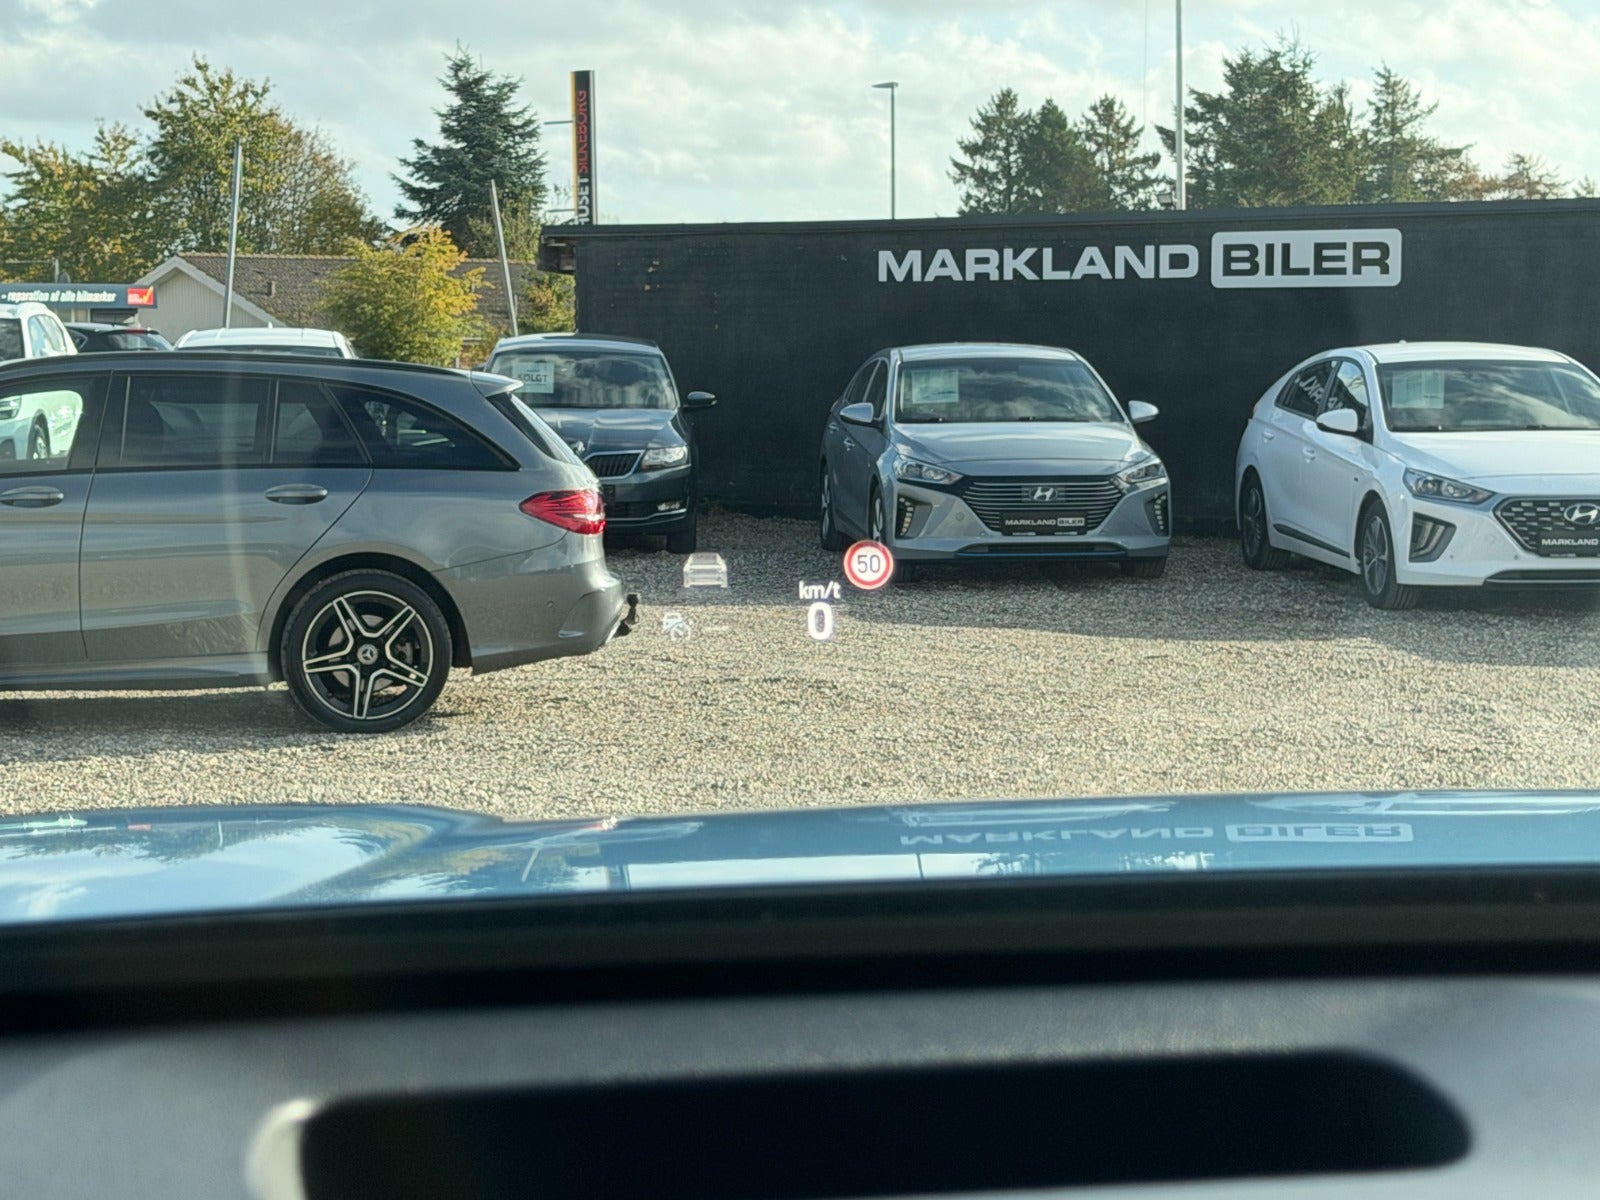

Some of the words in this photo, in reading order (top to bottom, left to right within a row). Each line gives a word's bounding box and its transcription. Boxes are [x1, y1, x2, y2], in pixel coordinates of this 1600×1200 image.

[577, 90, 589, 174] SILKEBORG
[877, 244, 1199, 282] MARKLAND
[1220, 240, 1392, 278] BILER
[857, 554, 881, 574] 50
[799, 580, 842, 599] km/t
[807, 602, 834, 640] 0
